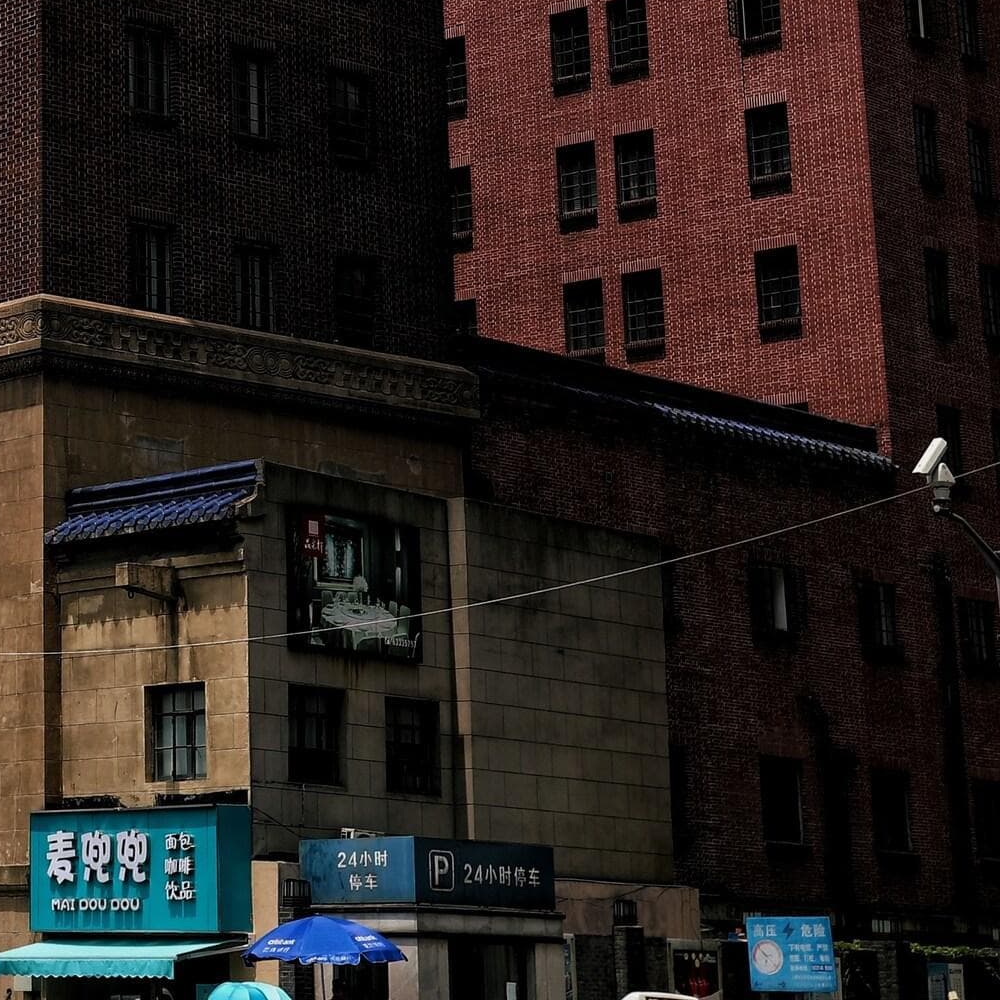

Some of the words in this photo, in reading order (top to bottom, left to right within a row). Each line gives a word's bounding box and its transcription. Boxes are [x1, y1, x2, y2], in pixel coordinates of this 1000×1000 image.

[165, 832, 195, 850] 面包
[46, 829, 148, 884] 麦兜兜
[337, 850, 388, 869] 24小时
[164, 858, 195, 875] 咖啡
[434, 855, 449, 886] P
[464, 863, 541, 888] 24小时停车
[165, 881, 196, 900] 饮品
[349, 873, 379, 891] 停车
[51, 898, 75, 911] MAI
[79, 898, 106, 911] DOU
[110, 898, 140, 911] DOU
